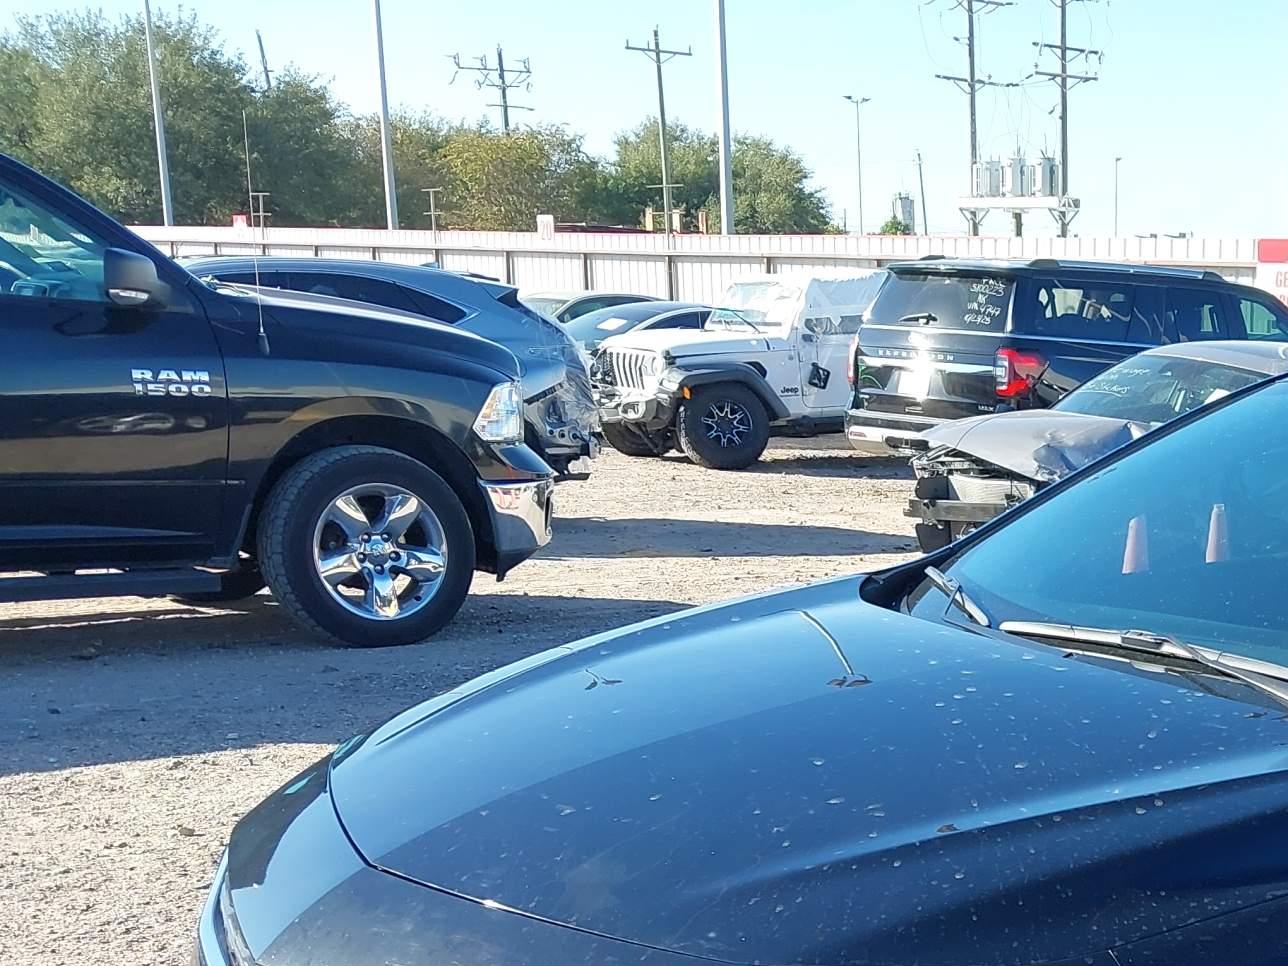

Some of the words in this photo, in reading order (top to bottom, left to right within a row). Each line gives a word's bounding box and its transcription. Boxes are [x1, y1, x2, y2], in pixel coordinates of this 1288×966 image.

[131, 368, 210, 383] RAM
[133, 383, 212, 397] 1500
[780, 386, 800, 394] Jeep
